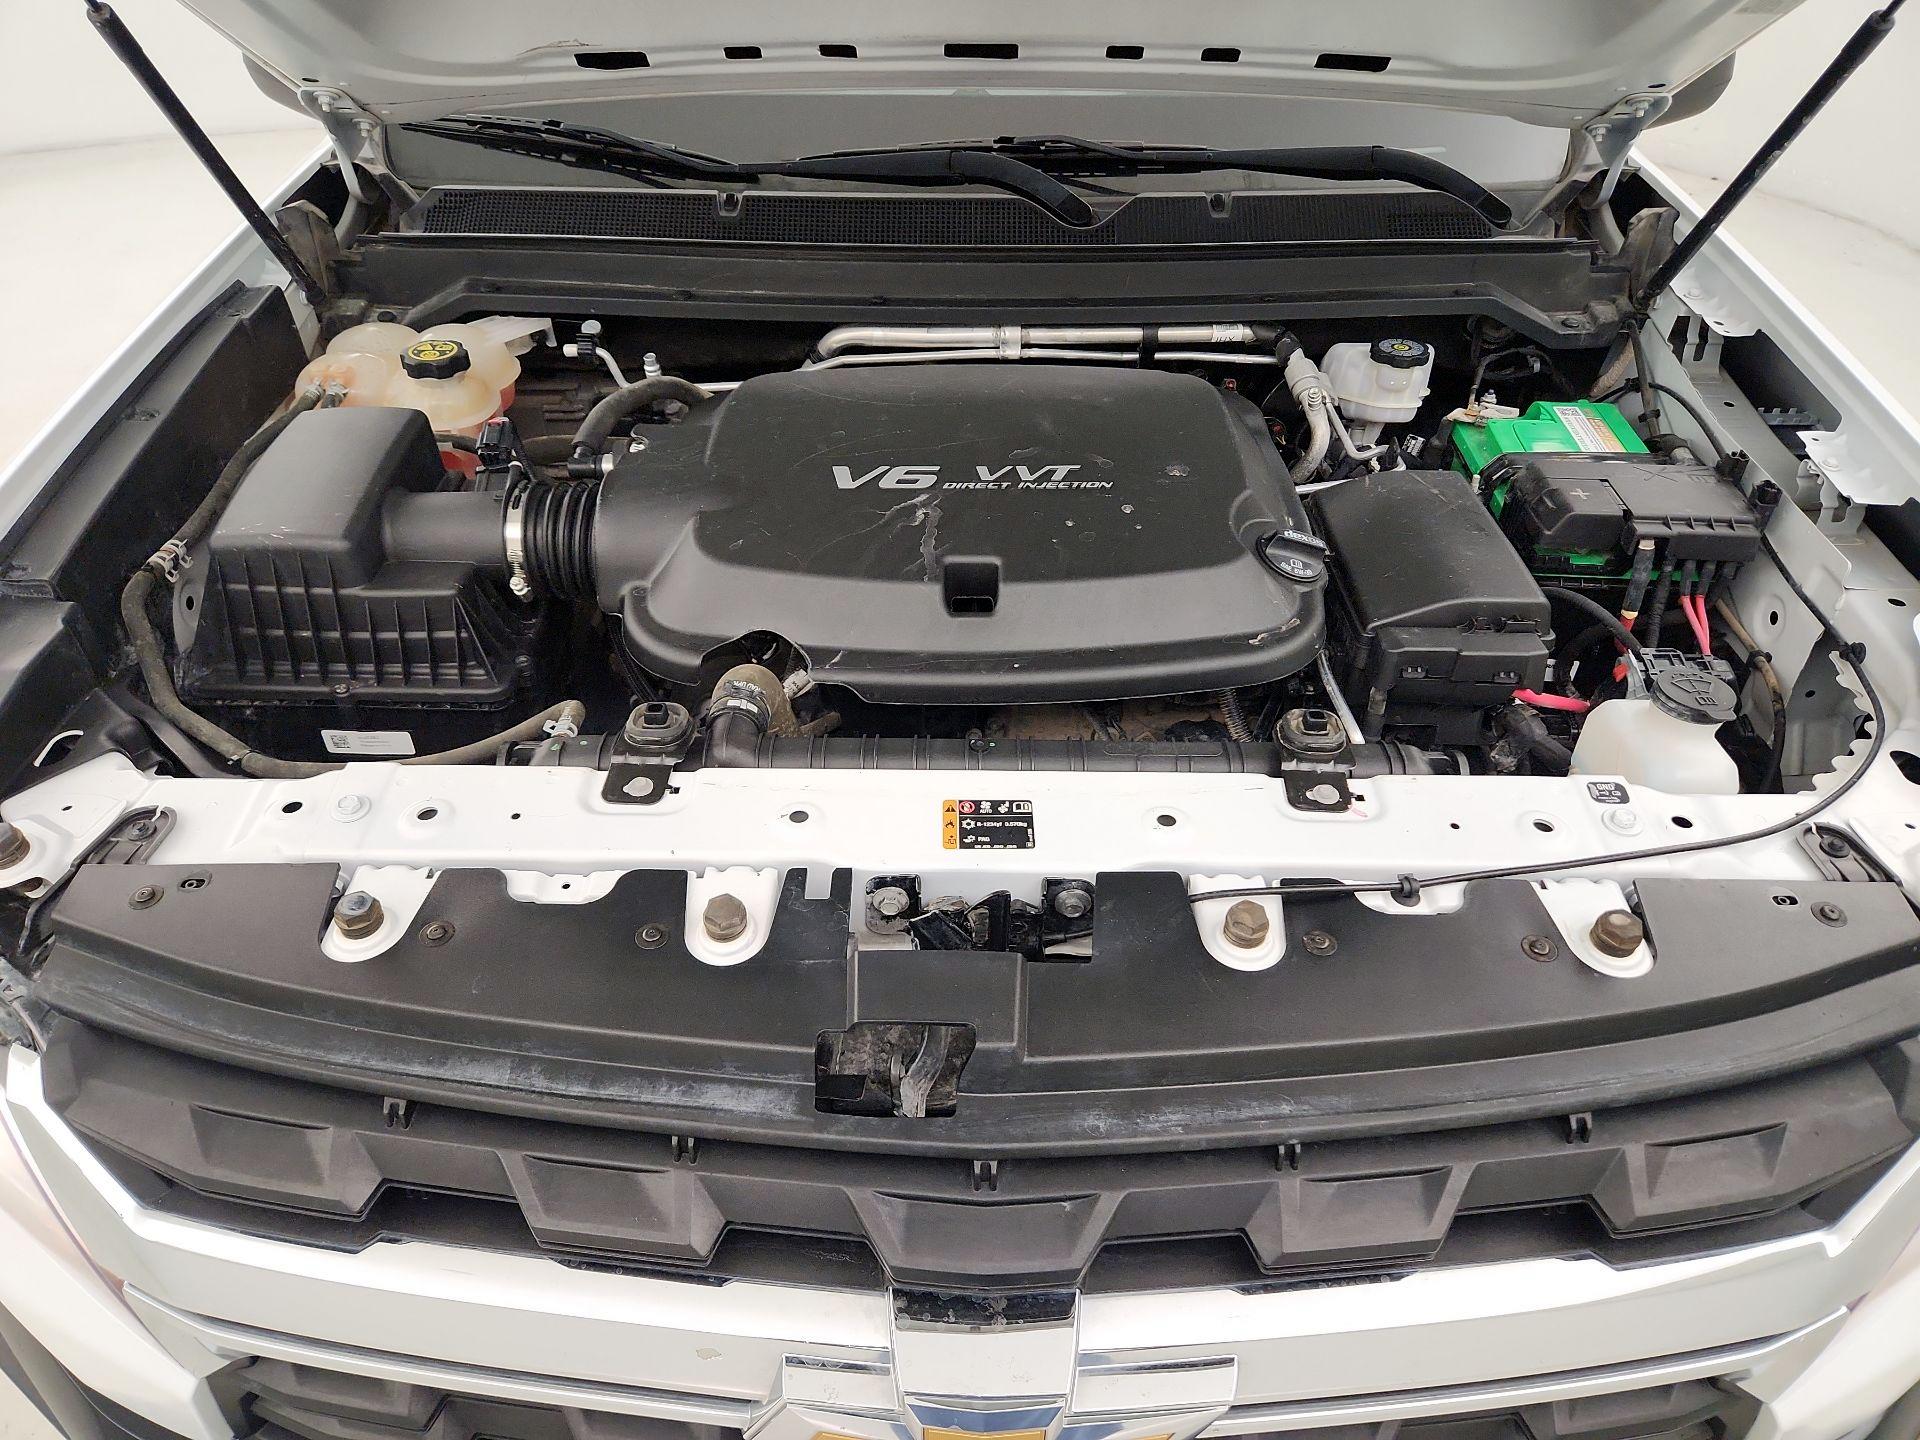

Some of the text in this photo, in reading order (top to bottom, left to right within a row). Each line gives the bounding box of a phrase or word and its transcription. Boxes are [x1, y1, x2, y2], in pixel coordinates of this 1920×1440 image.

[831, 465, 1082, 489] V6 VVT
[942, 481, 1114, 490] DIRECT INJECTION
